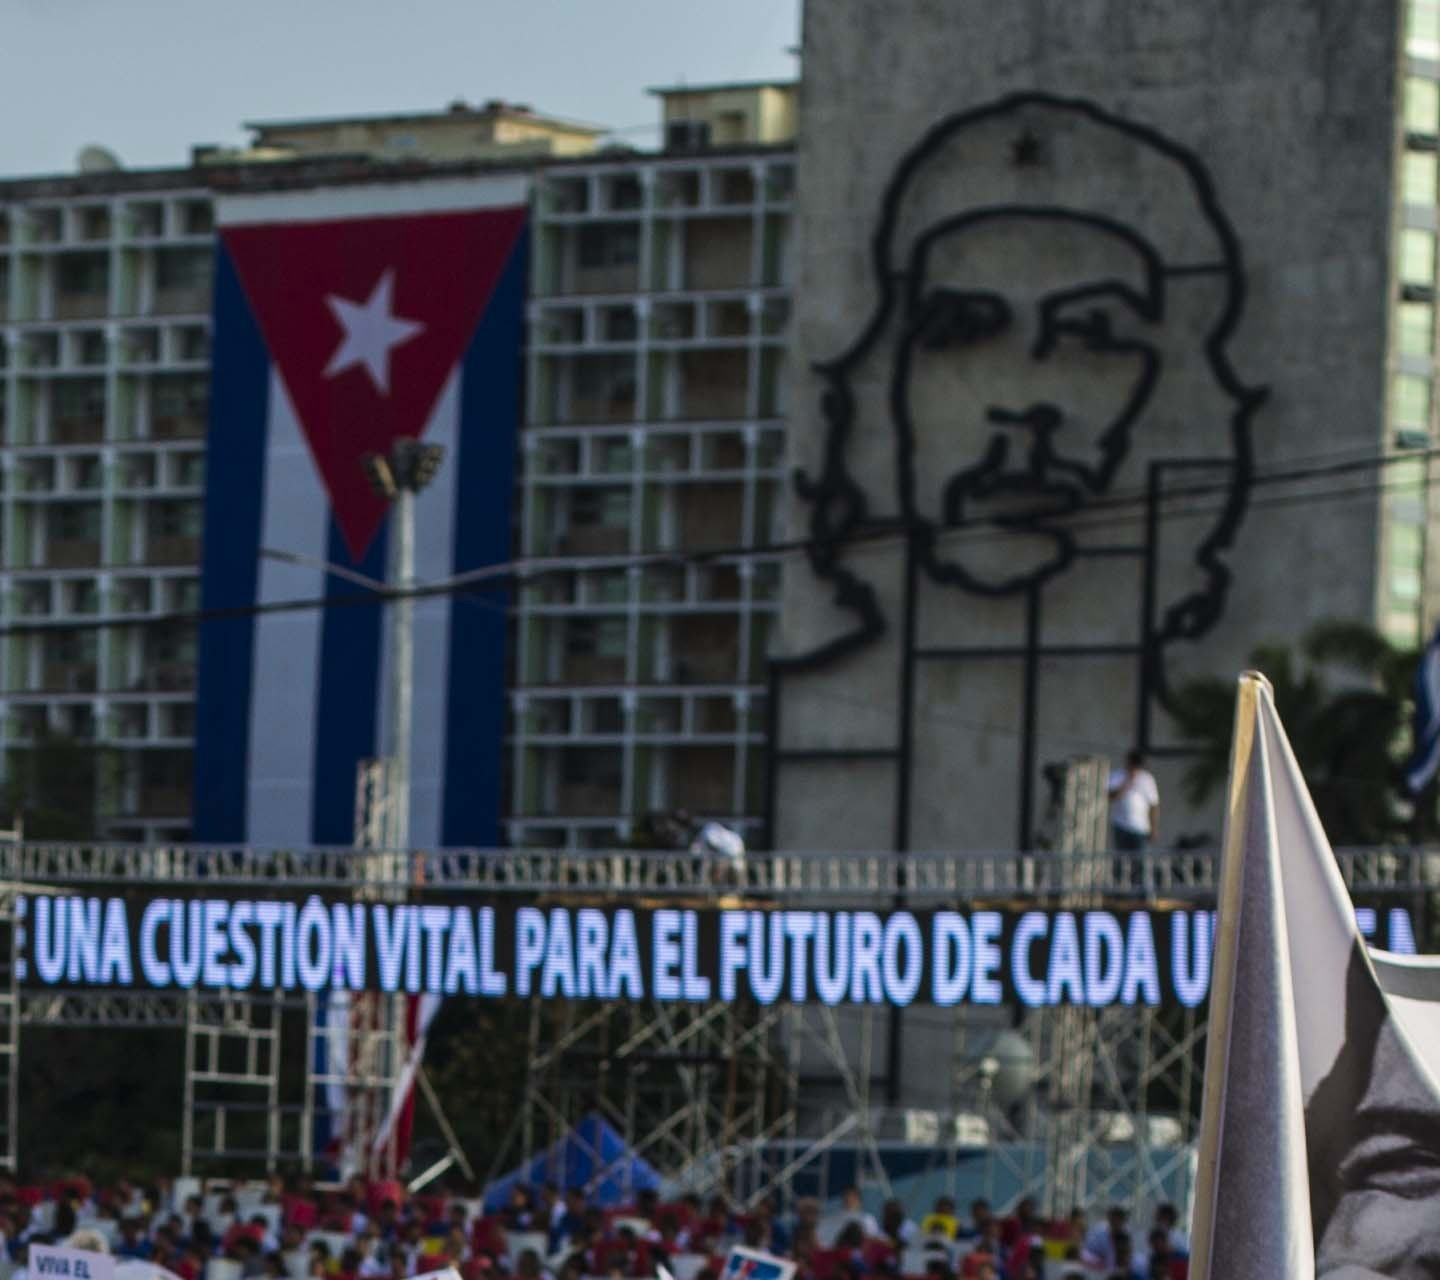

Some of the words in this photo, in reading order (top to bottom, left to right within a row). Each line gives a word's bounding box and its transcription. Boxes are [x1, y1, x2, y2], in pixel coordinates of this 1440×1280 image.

[36, 897, 132, 984] UNA
[140, 895, 366, 991] CUESTIÓN
[373, 905, 507, 997] VITAL
[516, 907, 644, 999] PARA
[652, 909, 710, 1002] EL
[722, 910, 922, 1007] FUTURO
[932, 911, 1003, 1006] DE
[1011, 911, 1161, 1007] CADA
[1171, 910, 1218, 1007] U
[74, 1259, 90, 1279] EL
